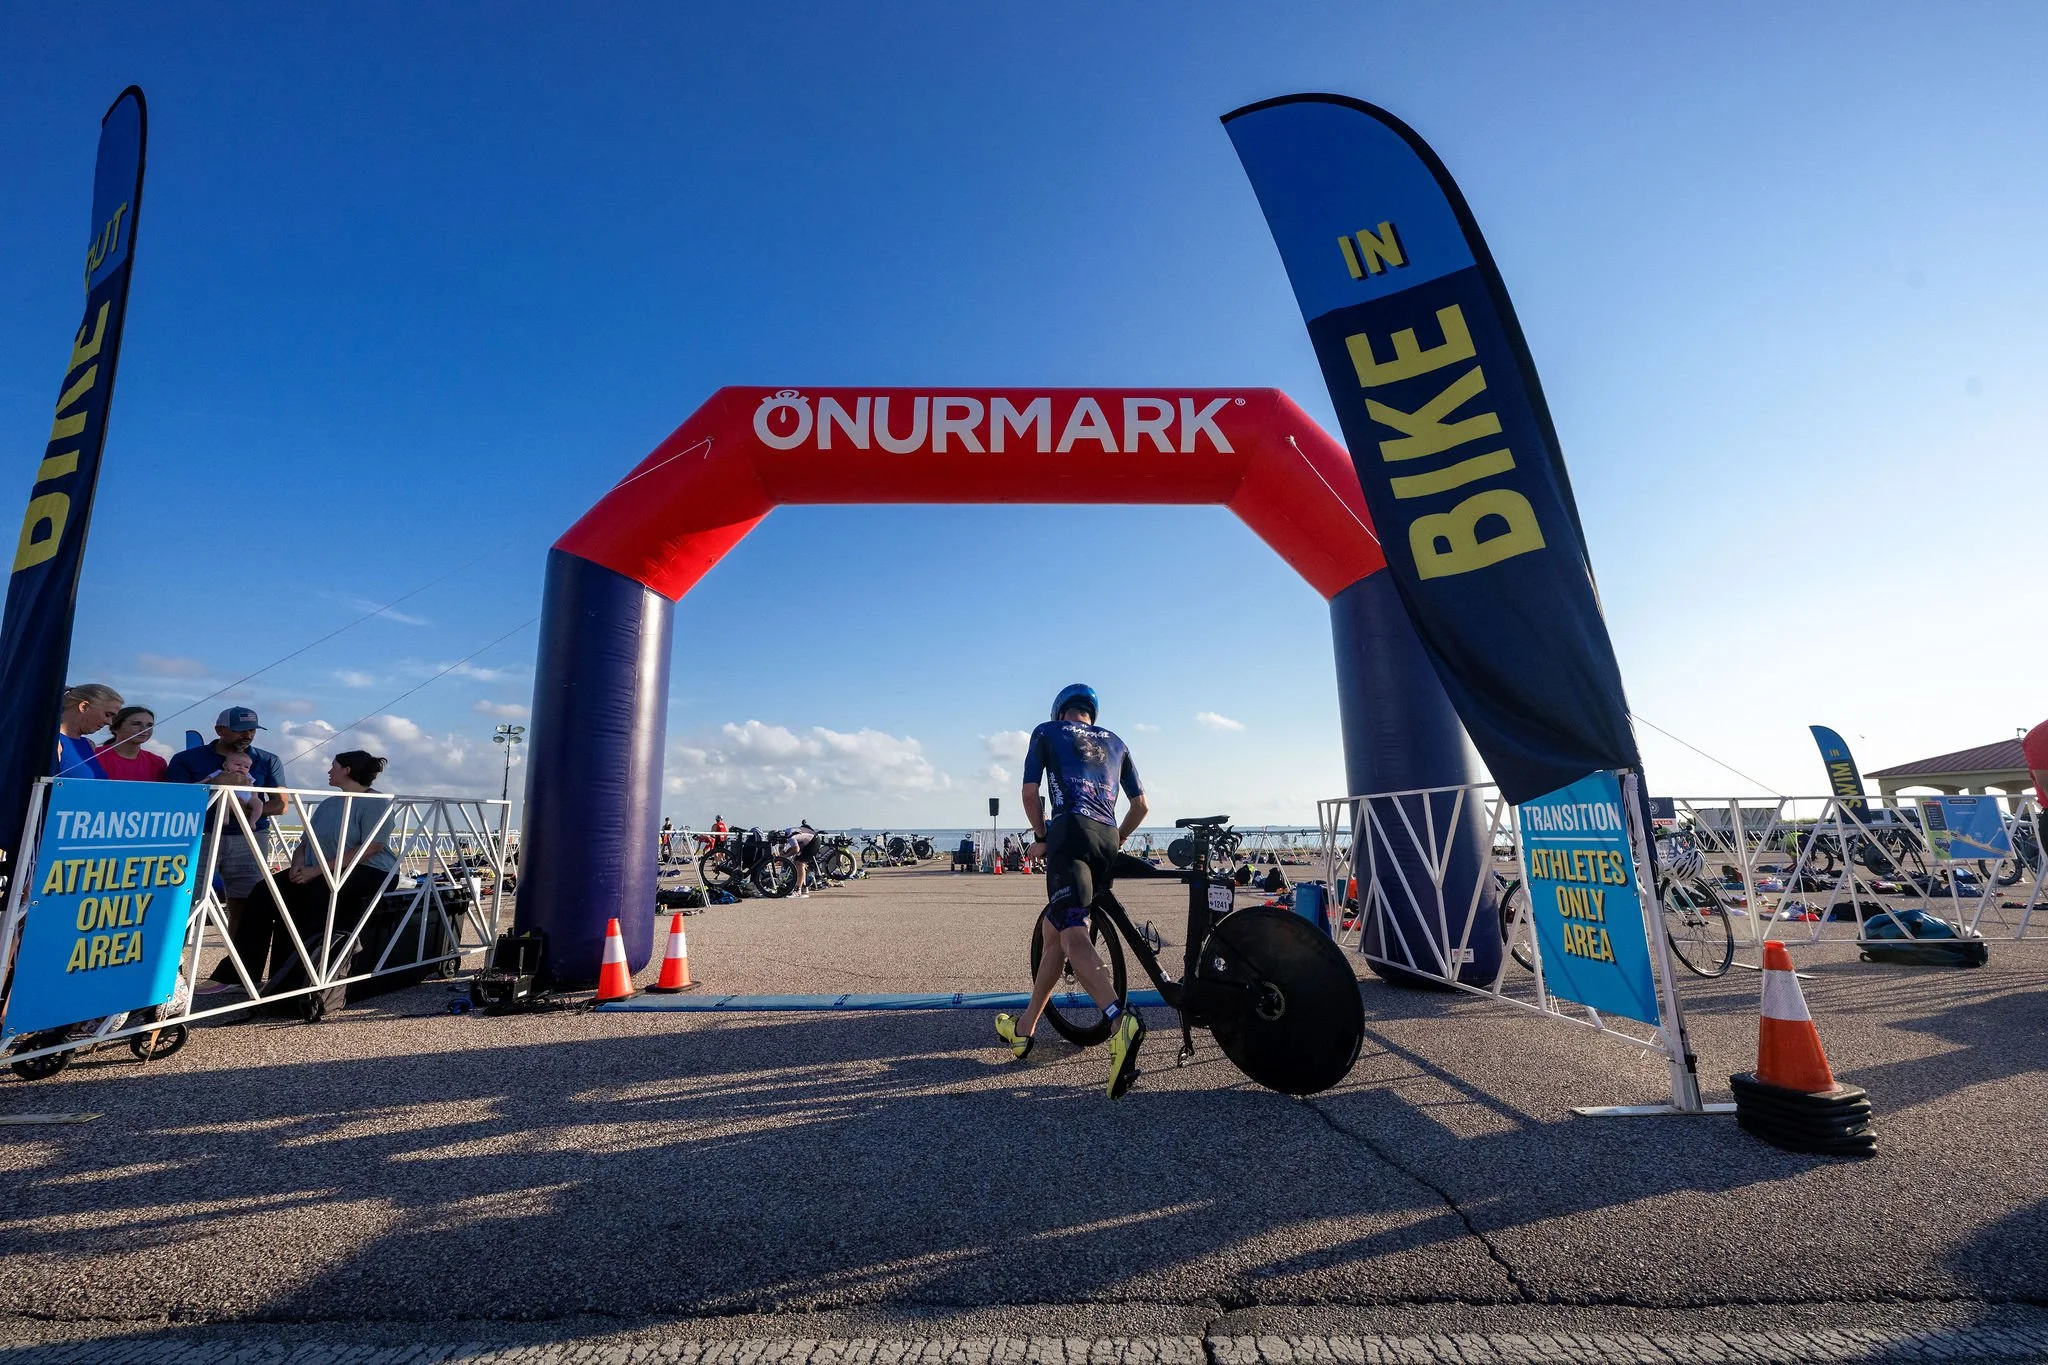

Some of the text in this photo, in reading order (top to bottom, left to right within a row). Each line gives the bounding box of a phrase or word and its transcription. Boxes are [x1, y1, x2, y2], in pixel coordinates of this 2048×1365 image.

[1337, 220, 1405, 280] IN
[1344, 303, 1547, 581] BIKE
[56, 811, 200, 840] TRANSITION
[1522, 802, 1622, 832] TRANSITION
[41, 855, 187, 895] ATHLETES
[1531, 848, 1628, 887] ATHLETES
[77, 893, 153, 932] ONLY
[1214, 900, 1227, 909] 1241
[1555, 885, 1607, 923] ONLY
[66, 931, 144, 974] AREA
[1562, 922, 1615, 963] AREA
